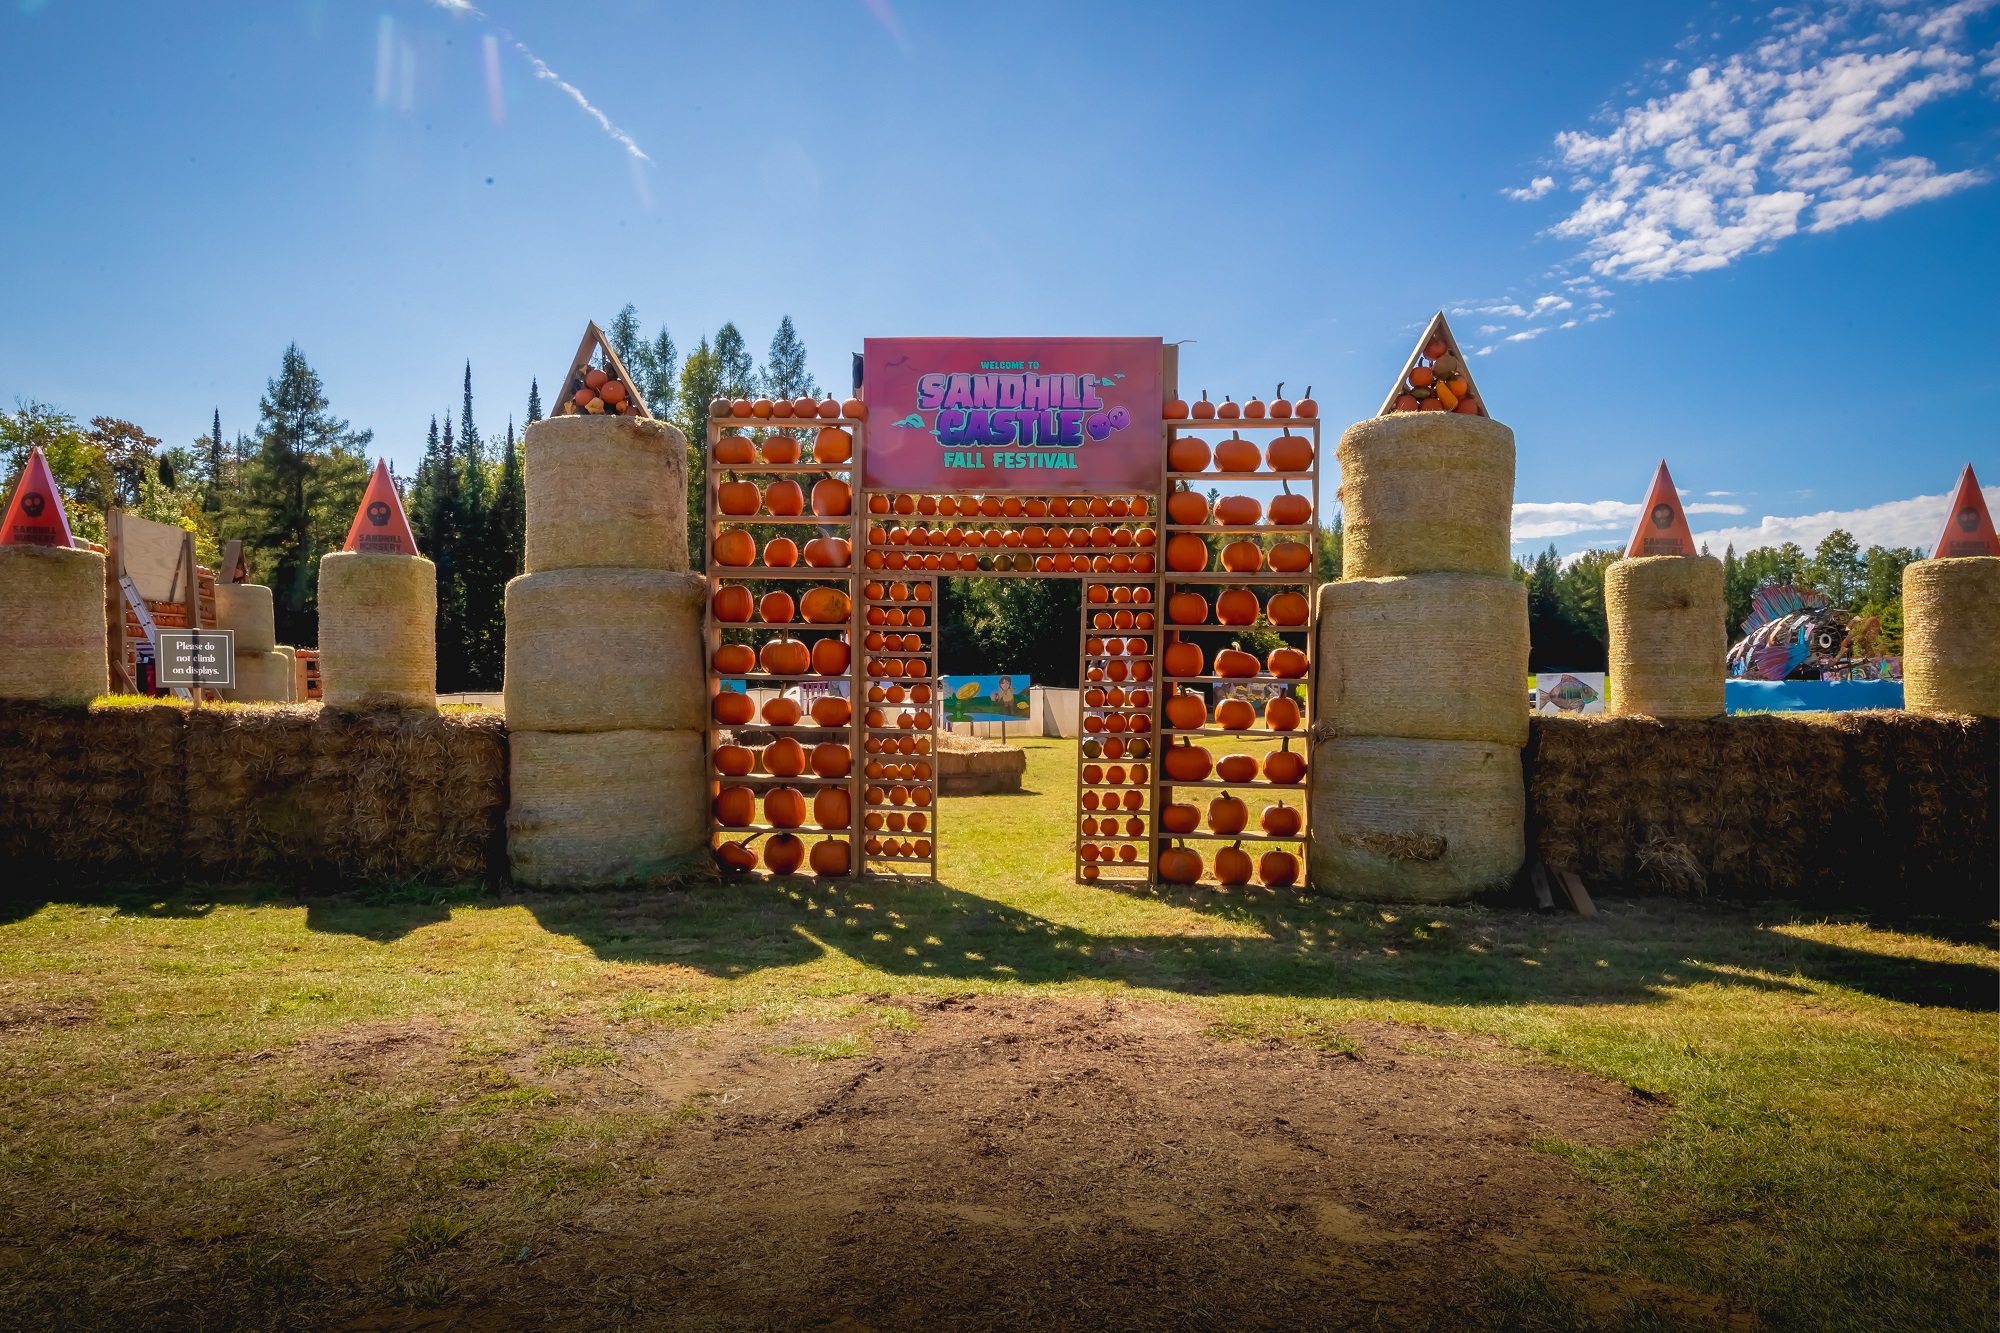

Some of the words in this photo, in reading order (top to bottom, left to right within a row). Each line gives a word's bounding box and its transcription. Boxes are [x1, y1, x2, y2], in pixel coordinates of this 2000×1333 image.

[980, 361, 1025, 370] WELCOME
[1027, 361, 1040, 370] TO
[917, 372, 1103, 411] SANDHILL
[935, 408, 1085, 447] CASTLE
[944, 452, 985, 469] FALL
[993, 452, 1079, 469] FESTIVAL
[359, 534, 402, 542] SANDHILL
[176, 641, 203, 651] Please
[204, 642, 215, 651] do
[193, 654, 216, 663] climb
[185, 666, 220, 676] displays.
